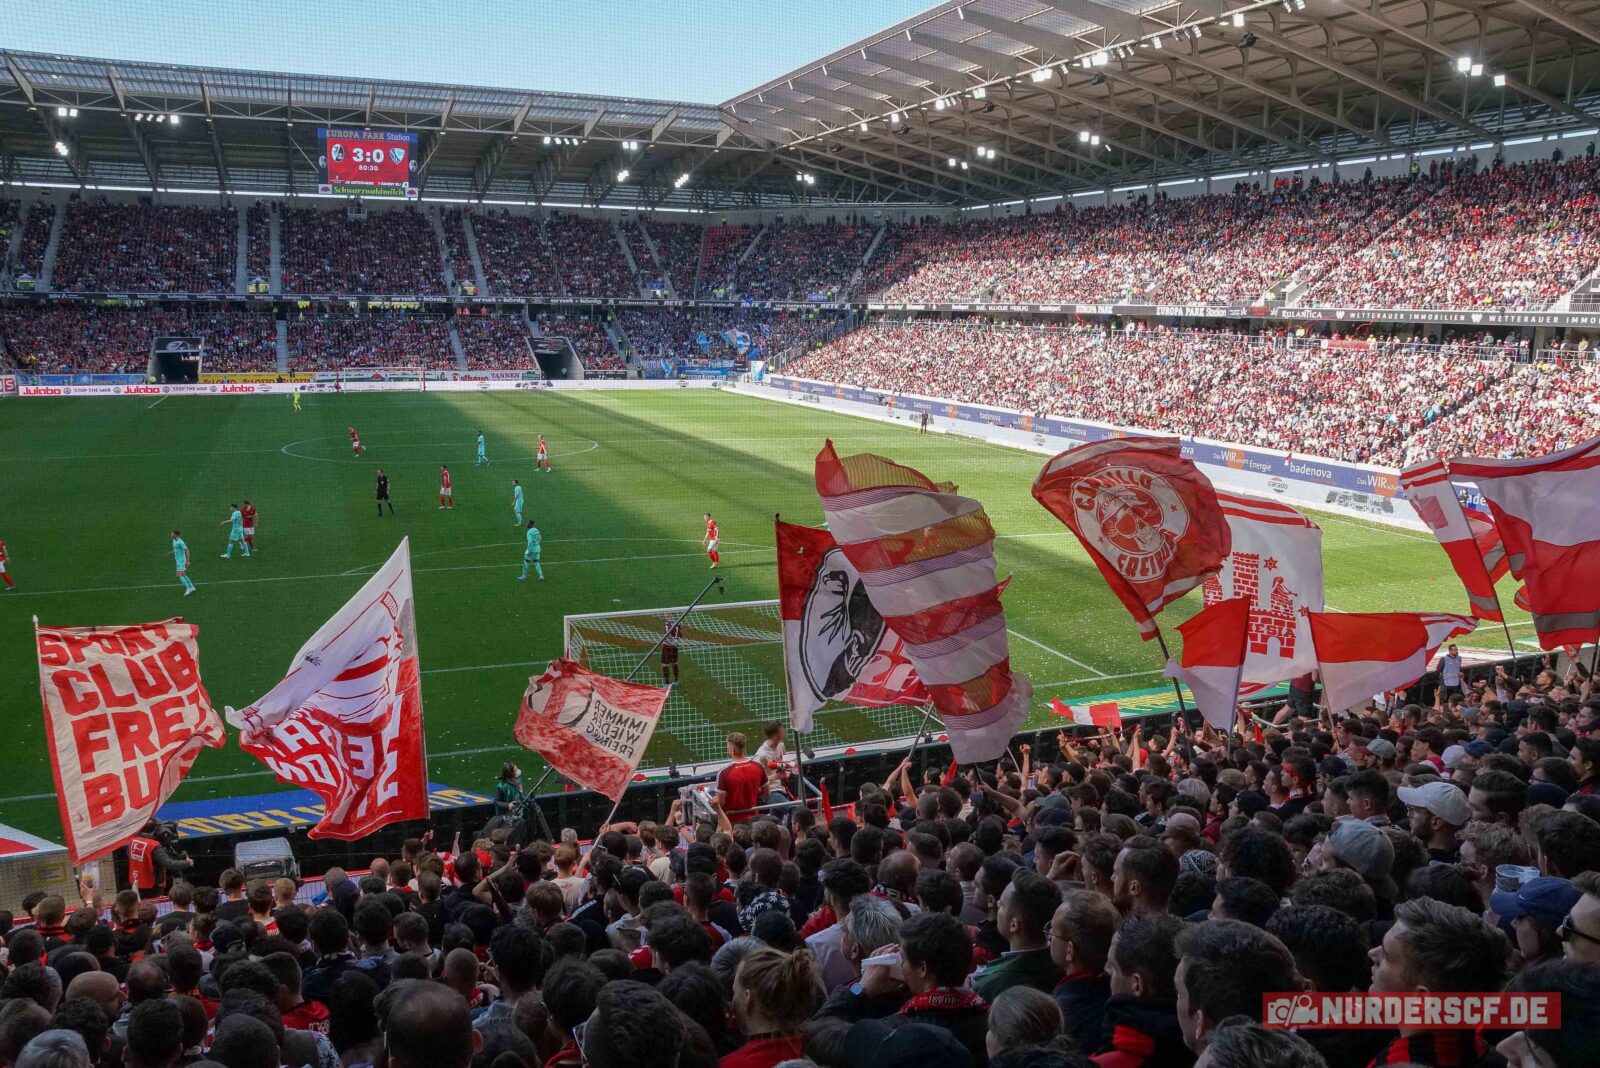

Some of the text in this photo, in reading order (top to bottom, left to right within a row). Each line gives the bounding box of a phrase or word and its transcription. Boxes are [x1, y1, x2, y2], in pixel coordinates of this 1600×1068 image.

[326, 130, 410, 141] EUROPA PARK Stadion
[352, 147, 385, 163] 3:0
[333, 186, 404, 196] Schwarzwaldmilch
[1156, 306, 1184, 316] EUROPA
[1185, 307, 1204, 317] PARK
[1349, 312, 1405, 321] WETTERAUER
[1489, 316, 1600, 325] WETTERAUER IMMO
[1060, 424, 1087, 437] badenova
[1221, 449, 1236, 462] WIR
[1249, 460, 1272, 473] Energie
[1289, 462, 1332, 479] badenova
[1356, 477, 1367, 485] Das
[1367, 475, 1386, 489] WIR
[51, 641, 197, 716] CLUB
